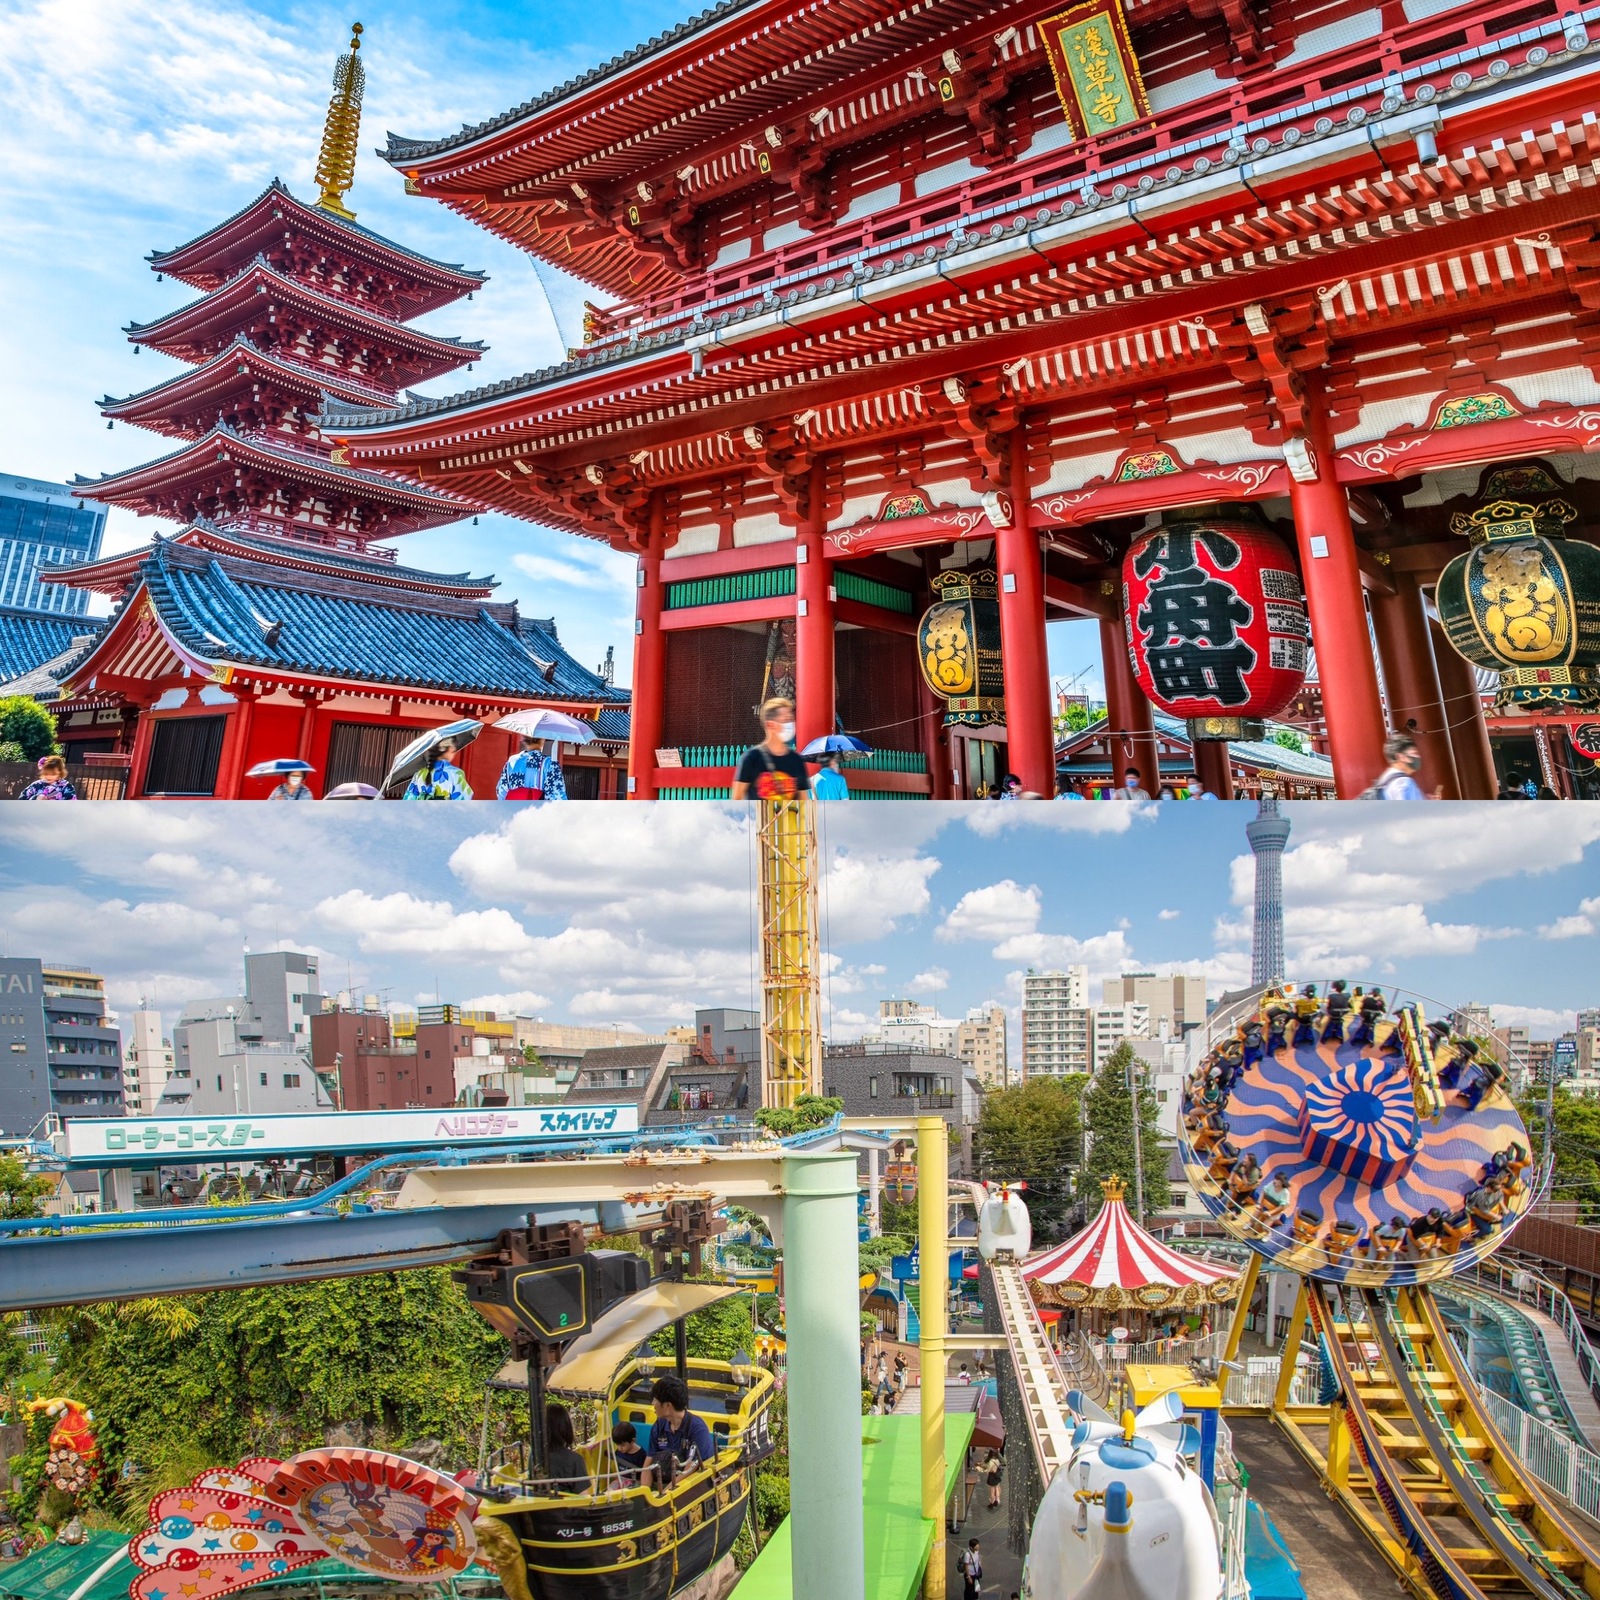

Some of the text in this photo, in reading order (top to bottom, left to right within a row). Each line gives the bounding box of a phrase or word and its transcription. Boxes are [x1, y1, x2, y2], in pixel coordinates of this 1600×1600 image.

[435, 1114, 518, 1136] ヘリコプター
[540, 1109, 617, 1132] スカイシップ
[106, 1124, 265, 1149] ローラーコースター
[560, 1313, 568, 1327] 2
[265, 1450, 465, 1519] CARNIVAL
[601, 1519, 634, 1534] 1853年
